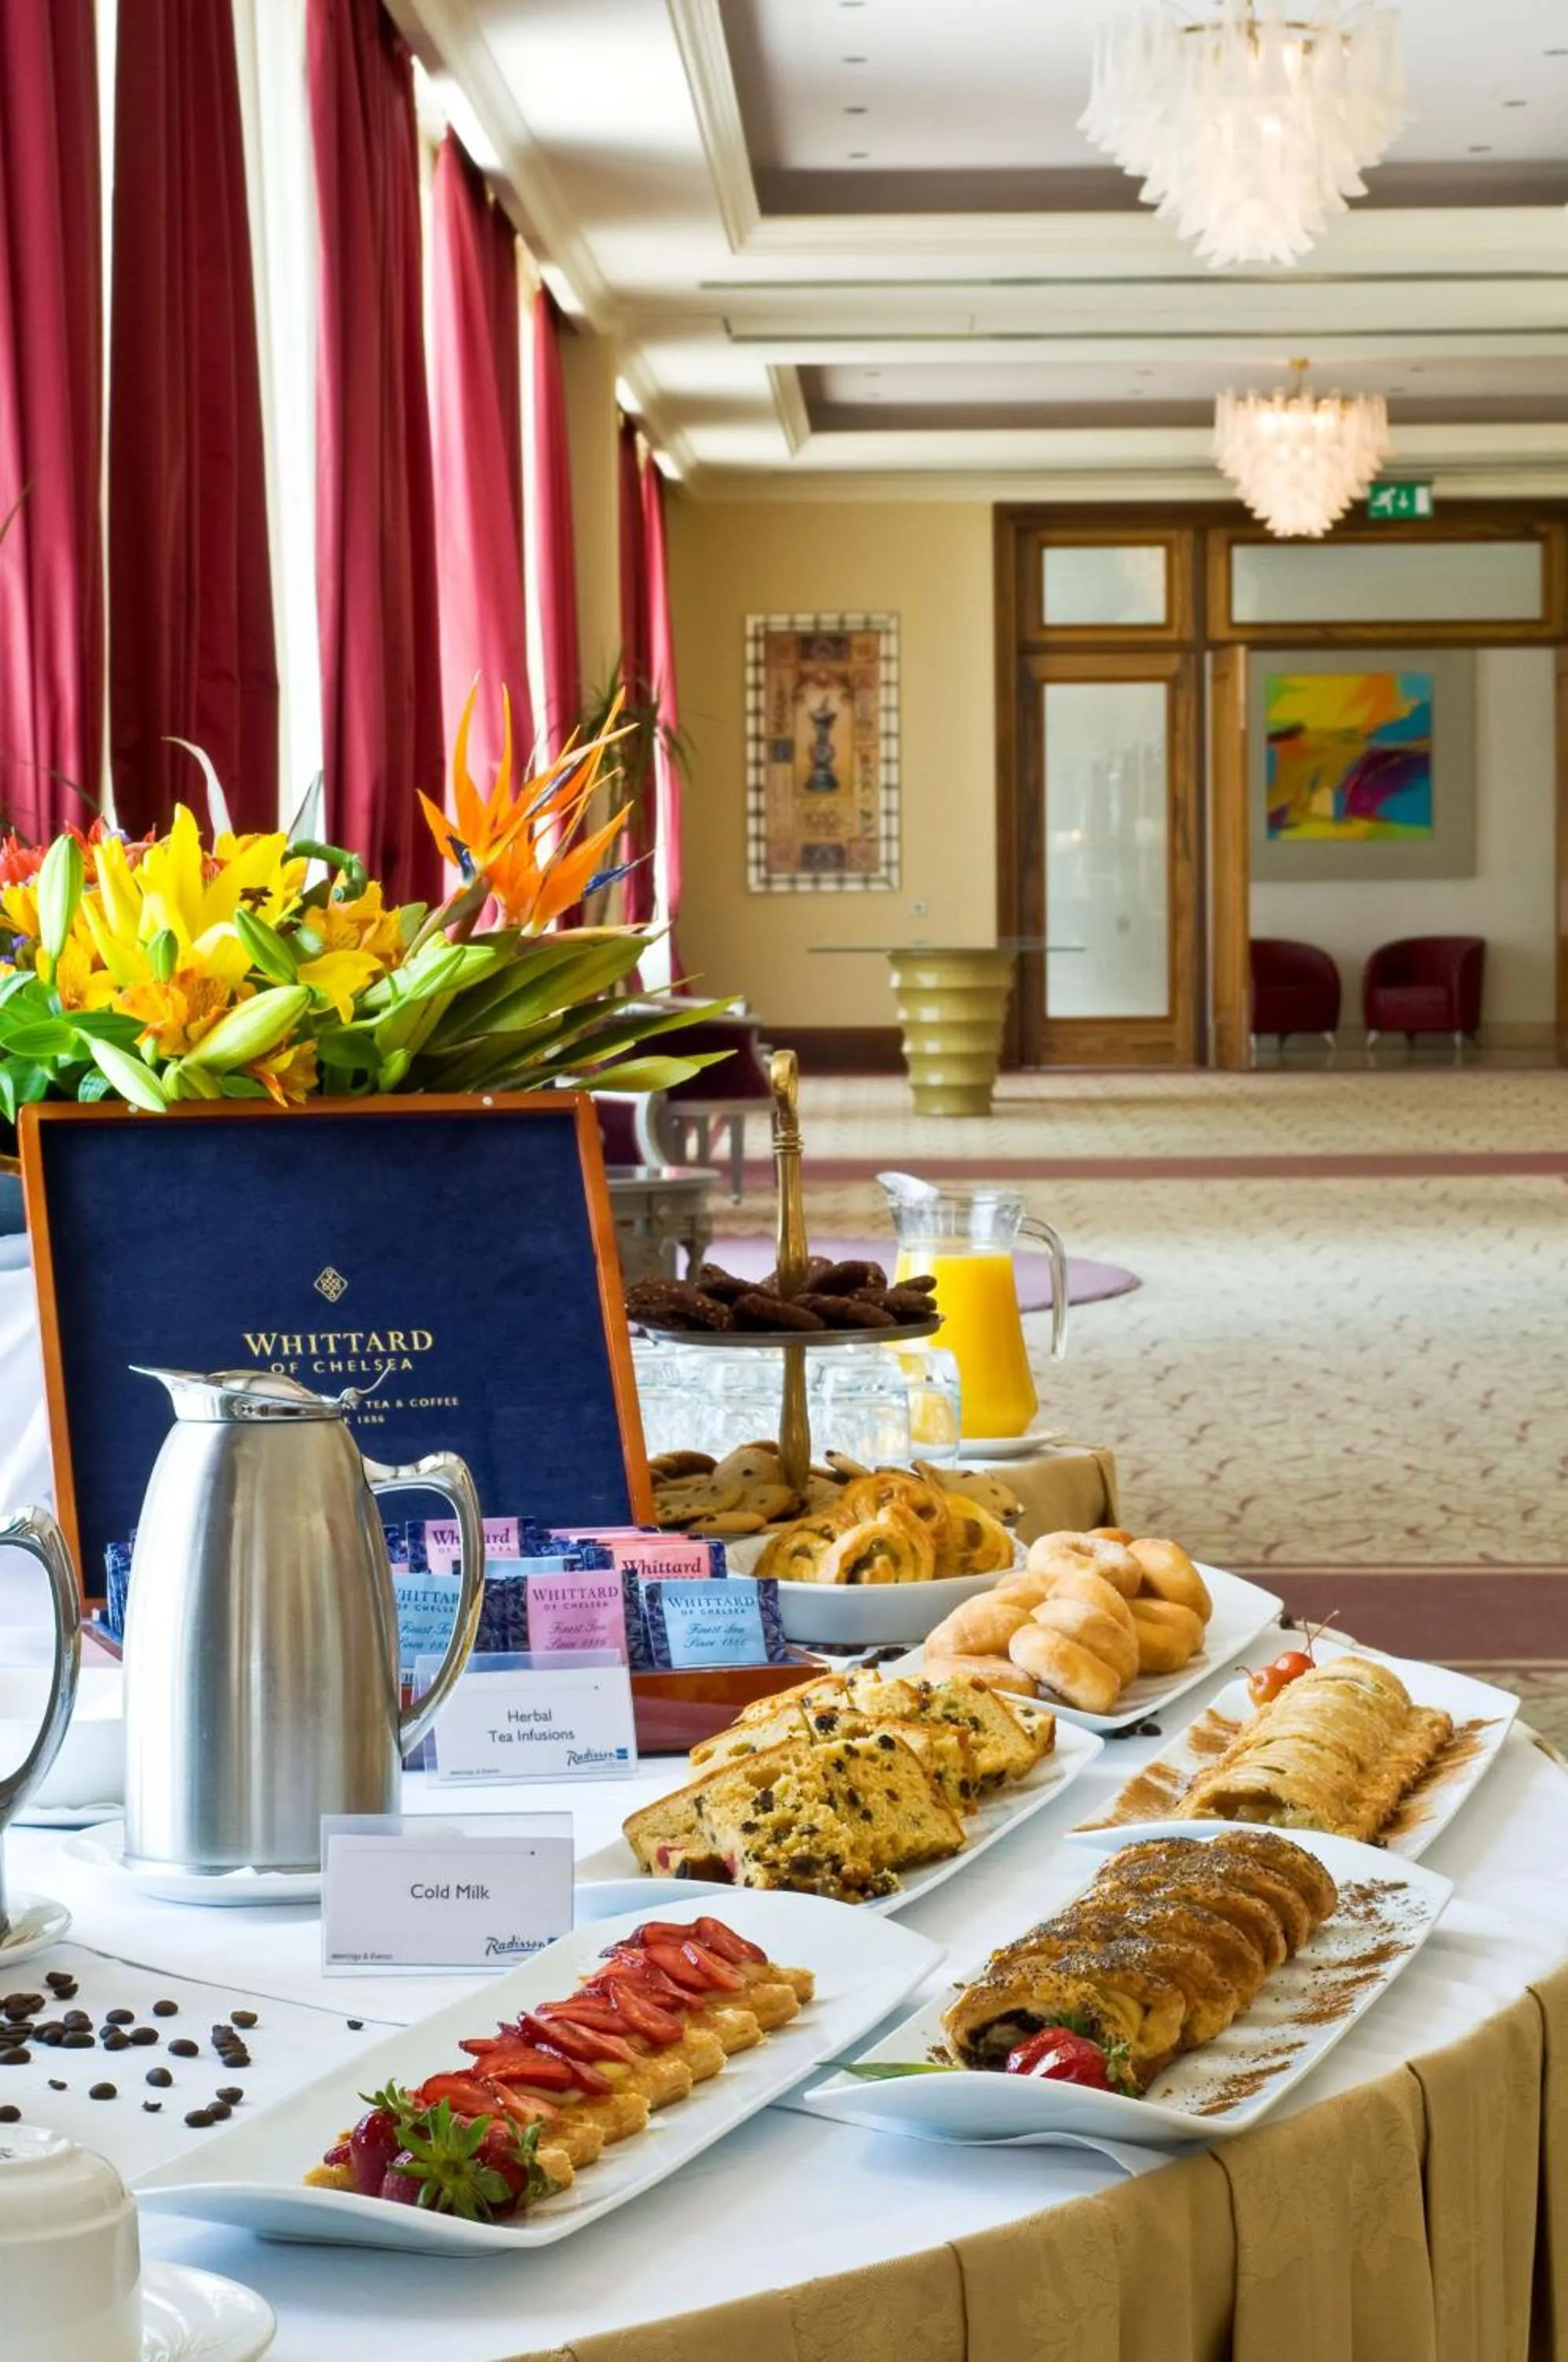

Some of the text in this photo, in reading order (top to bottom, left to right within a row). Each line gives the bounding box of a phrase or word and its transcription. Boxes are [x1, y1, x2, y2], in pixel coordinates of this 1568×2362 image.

[242, 1330, 435, 1357] WHITTARD
[271, 1358, 413, 1375] OF CHELSEA
[365, 1400, 390, 1409] TEA
[409, 1396, 460, 1409] COFFEE
[622, 1557, 702, 1575] Whittard
[533, 1586, 619, 1601] WHITTARD
[564, 1601, 608, 1610] CHELSEA
[669, 1597, 756, 1608] WHITTARD
[508, 1709, 553, 1722] Herbal
[487, 1727, 575, 1742] Tea Infusions
[566, 1746, 616, 1767] Radisson
[409, 1883, 490, 1900] Cold Milk
[485, 1934, 545, 1957] Radisson
